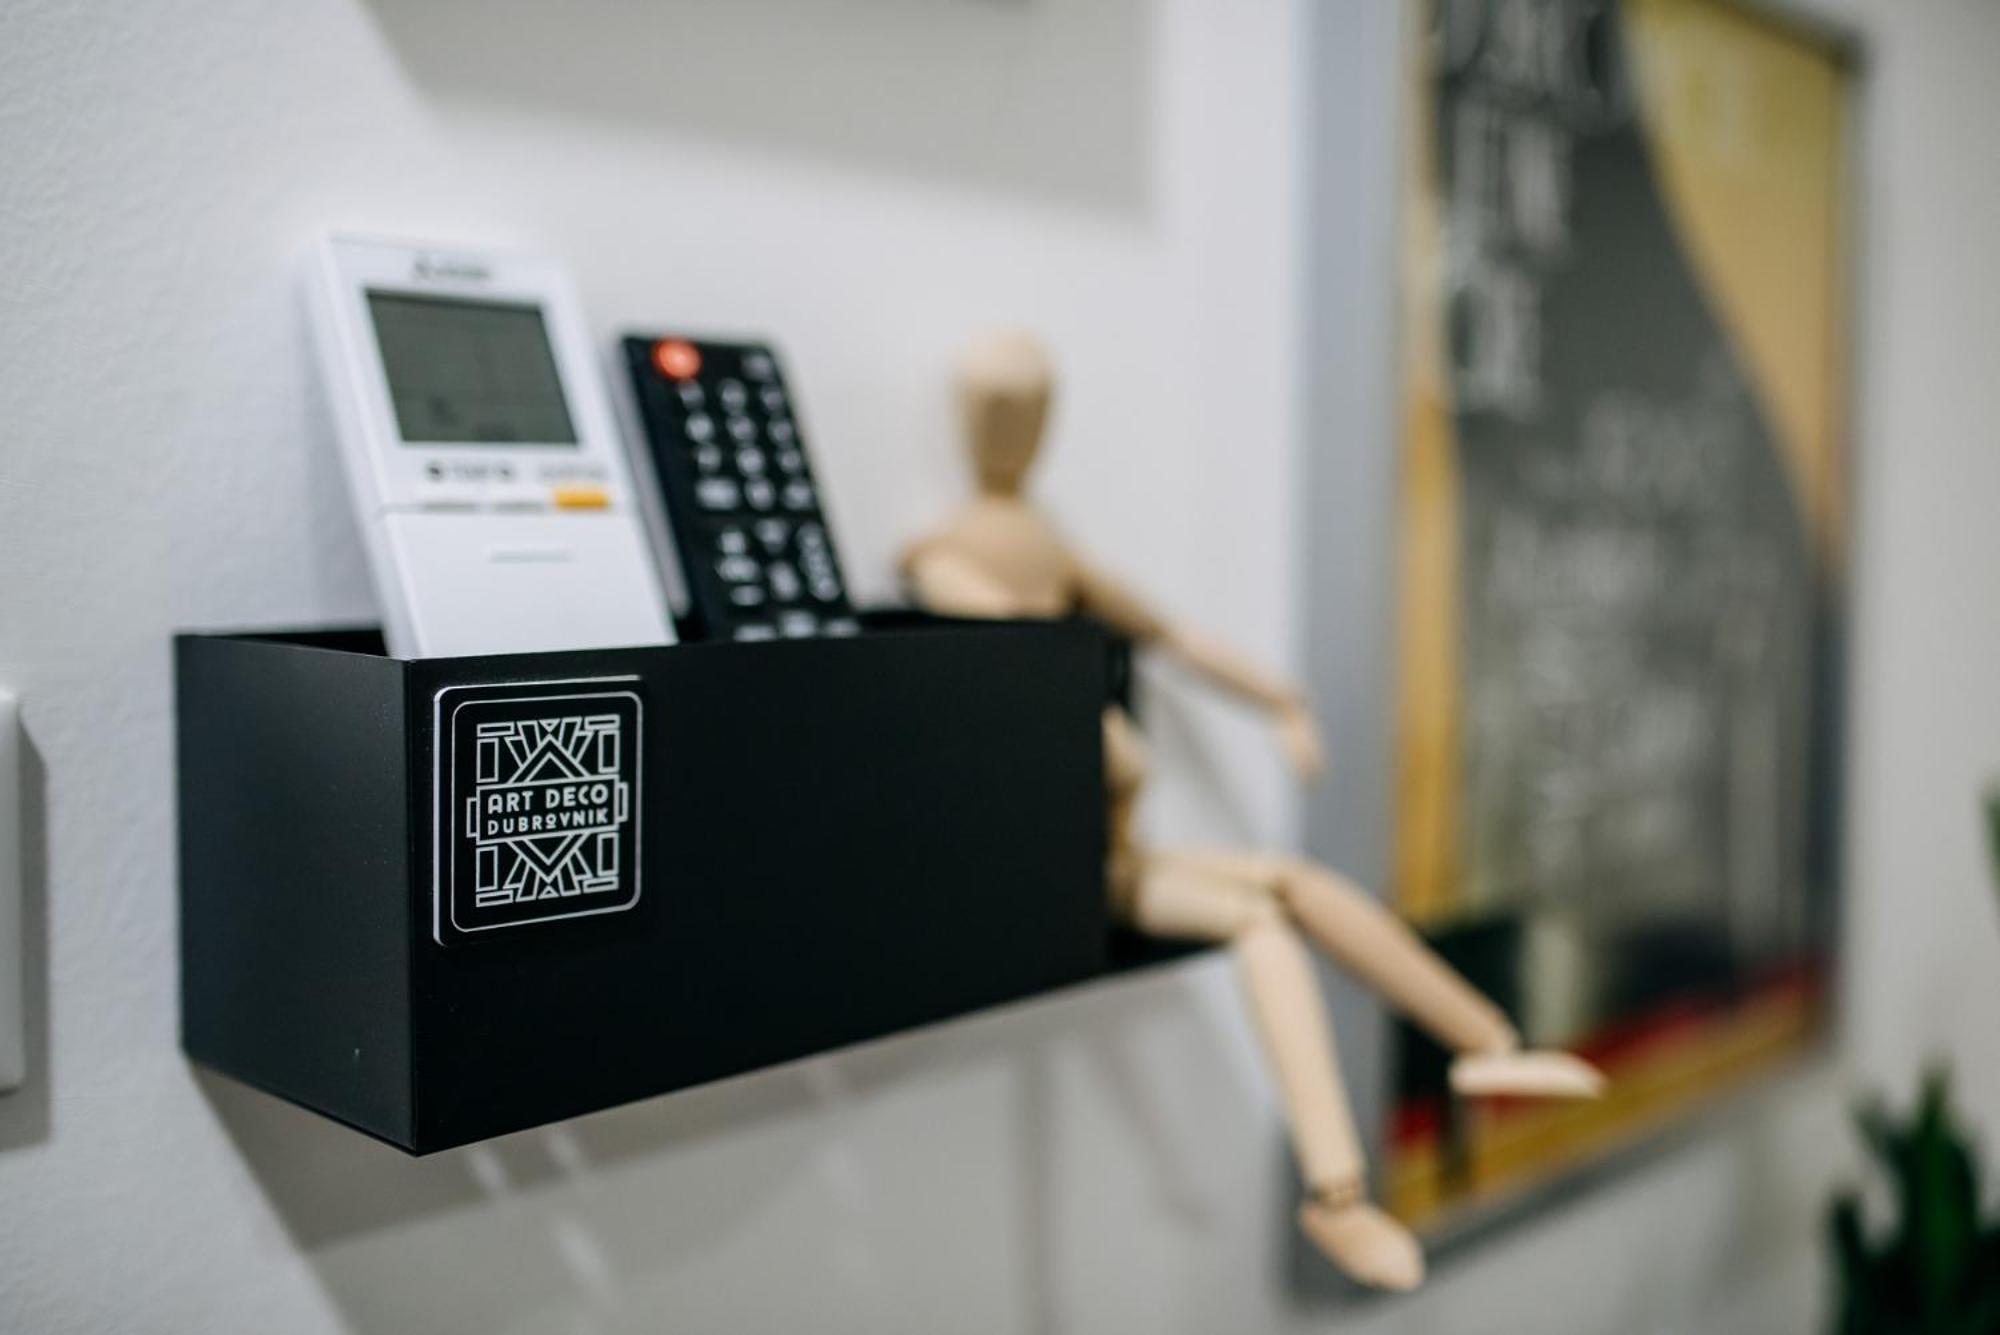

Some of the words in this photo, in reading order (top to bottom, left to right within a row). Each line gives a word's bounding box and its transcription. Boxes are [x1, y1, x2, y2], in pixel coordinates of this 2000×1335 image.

[488, 790, 534, 814] ART
[545, 783, 609, 808] DECO
[488, 809, 609, 835] DUBROVNIK
